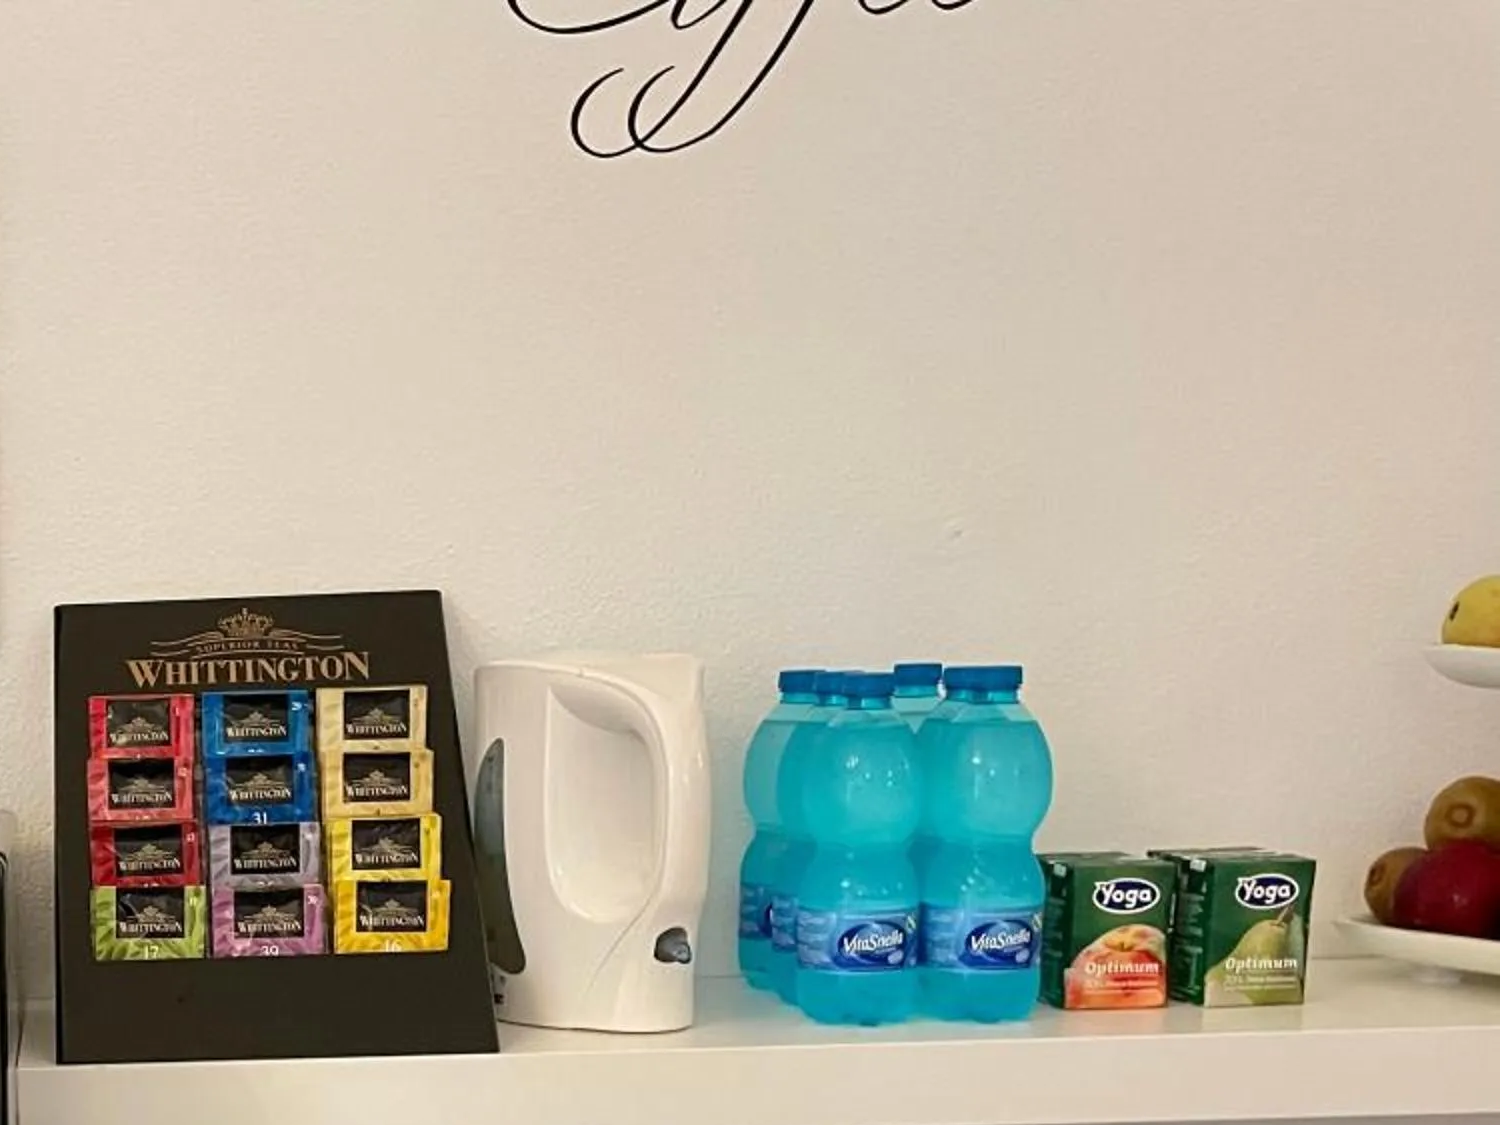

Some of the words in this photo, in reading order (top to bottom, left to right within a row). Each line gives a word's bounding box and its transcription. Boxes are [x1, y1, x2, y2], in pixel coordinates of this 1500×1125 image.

[126, 651, 370, 688] WHITTINGTON
[1101, 884, 1152, 908] Yoga
[1243, 879, 1291, 904] Yoga
[1085, 961, 1159, 978] Optimum
[1225, 956, 1298, 974] Optimum
